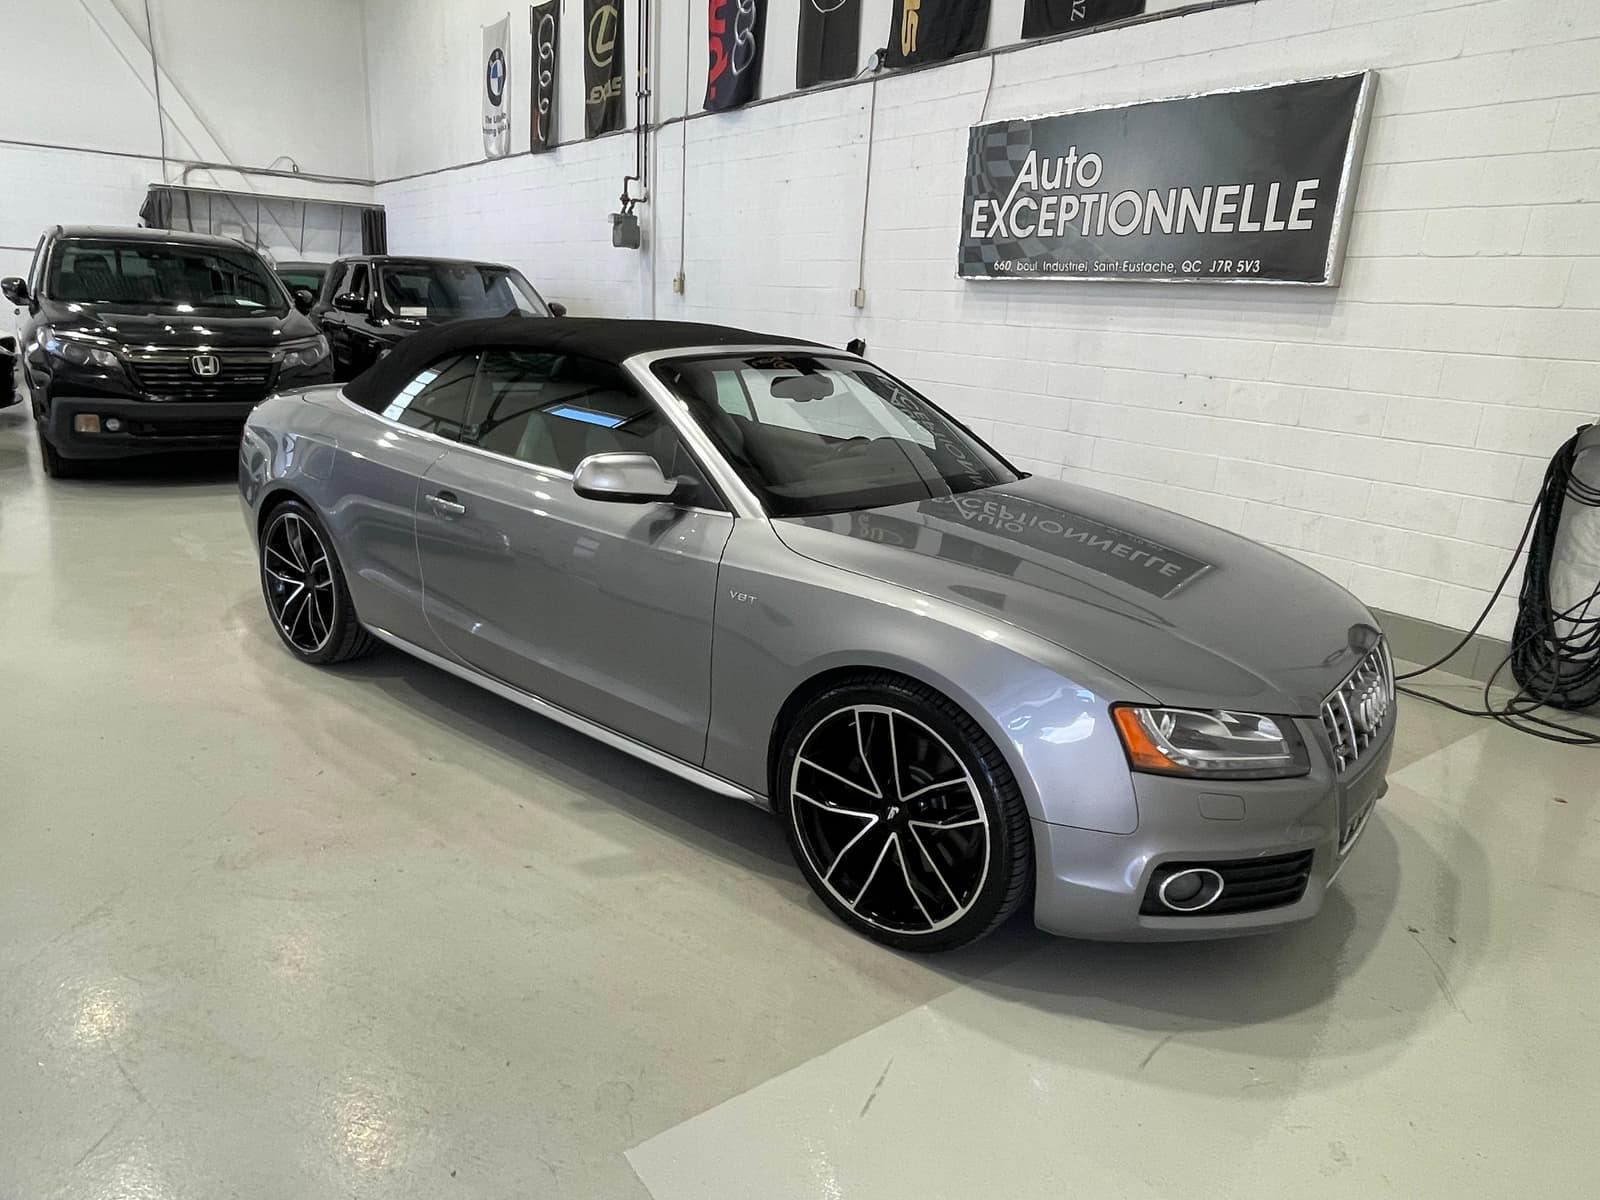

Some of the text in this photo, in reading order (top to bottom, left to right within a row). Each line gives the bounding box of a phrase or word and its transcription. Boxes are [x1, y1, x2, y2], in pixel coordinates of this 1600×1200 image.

[1015, 146, 1103, 190] Auto
[970, 180, 1320, 238] EXCEPTIONNELLE
[1093, 260, 1177, 274] Saint-Eustache,
[1181, 260, 1202, 273] QC
[1209, 260, 1233, 273] J7R
[1236, 260, 1260, 273] 5V3
